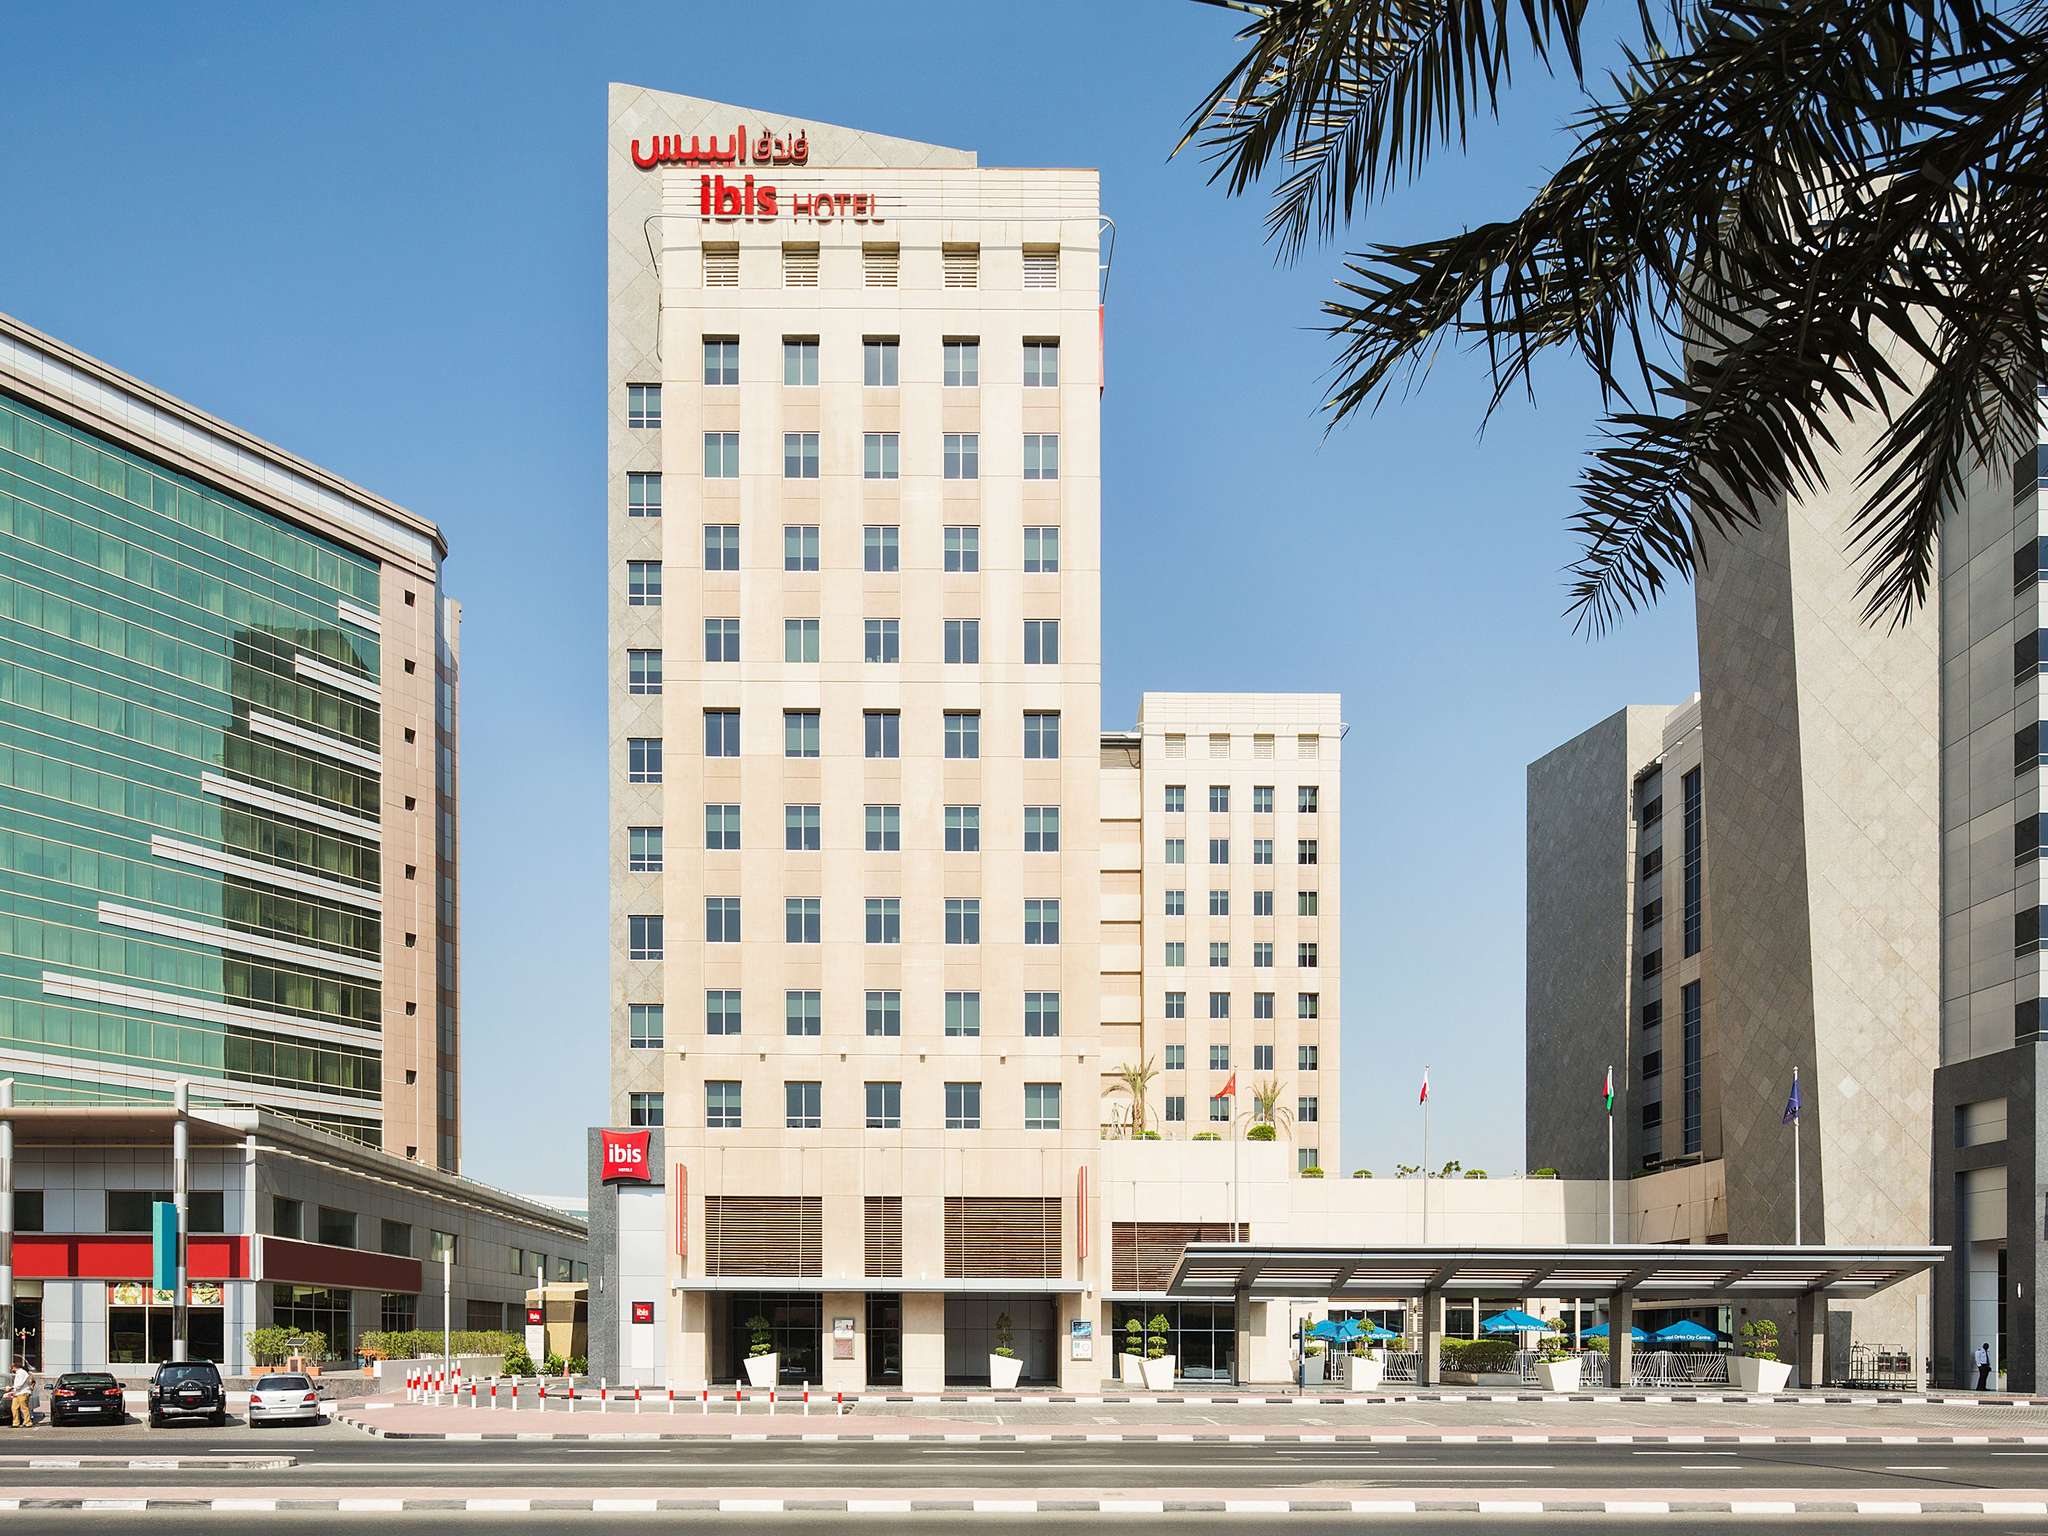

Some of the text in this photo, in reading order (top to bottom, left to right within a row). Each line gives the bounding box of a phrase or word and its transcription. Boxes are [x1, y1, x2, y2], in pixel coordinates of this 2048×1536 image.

[752, 129, 809, 166] فندق
[701, 174, 885, 222] ibis HOTEL
[608, 1144, 642, 1163] ibis
[529, 1312, 540, 1320] ibis
[636, 1307, 649, 1316] ibis
